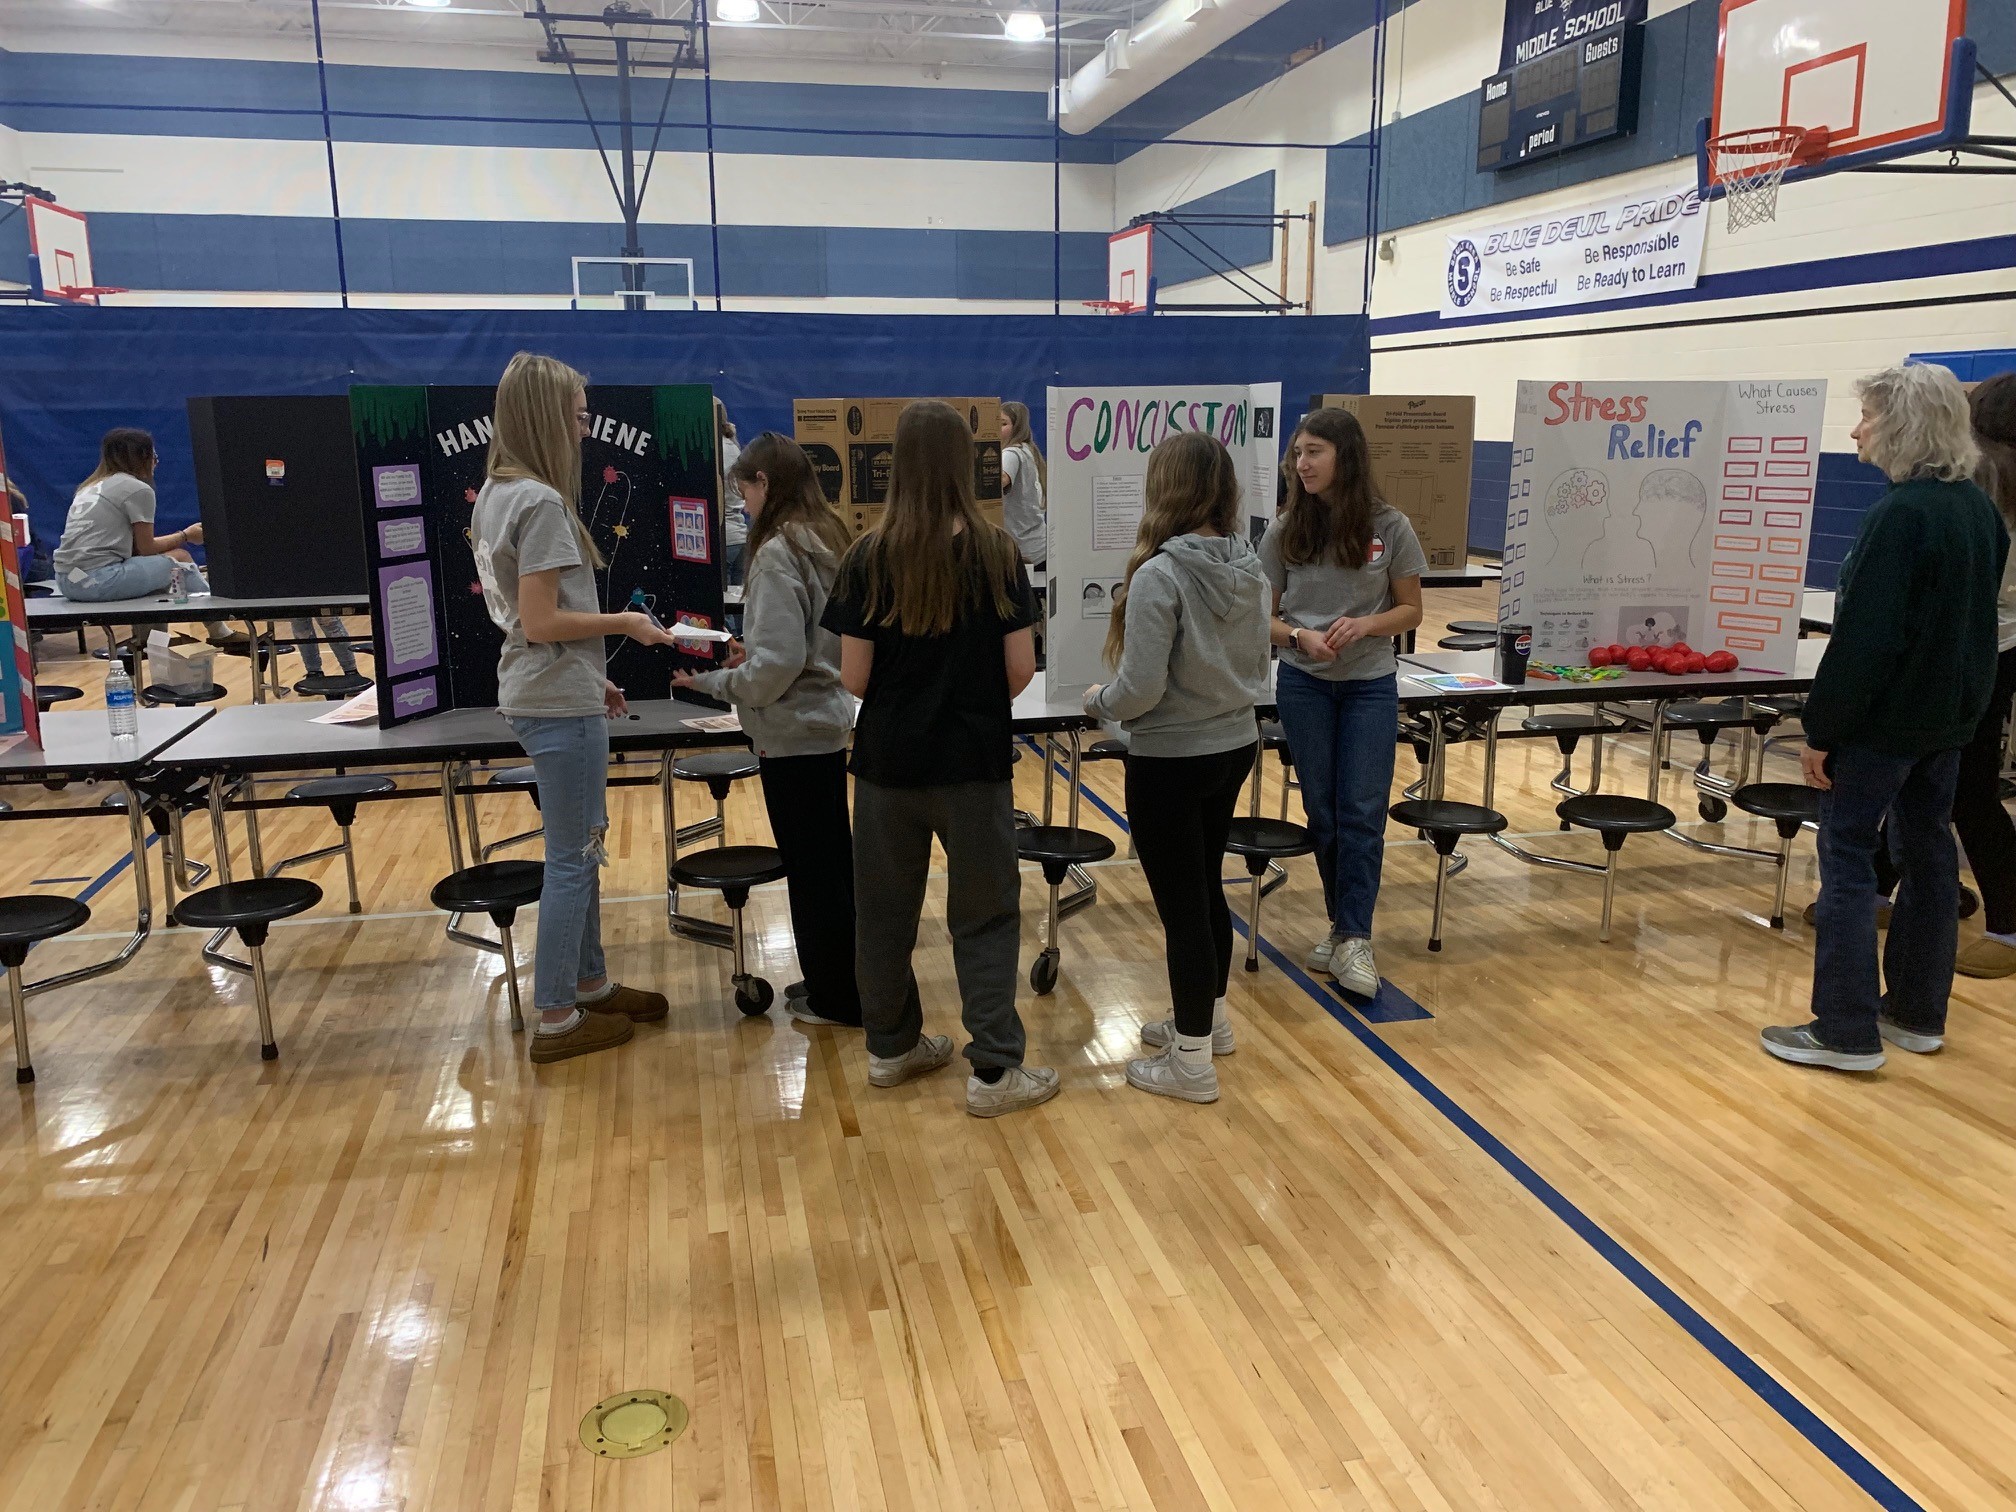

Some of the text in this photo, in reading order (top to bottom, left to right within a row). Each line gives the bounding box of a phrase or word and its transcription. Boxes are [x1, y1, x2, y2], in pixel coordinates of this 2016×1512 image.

[1535, 0, 1553, 14] BLUE
[1516, 1, 1625, 64] MIDDLE SCHOOL
[1585, 37, 1619, 63] Guests
[1486, 81, 1508, 101] Home
[1528, 124, 1556, 152] period
[1483, 189, 1701, 256] BLUE DEVIL PRIDE
[1585, 232, 1680, 264] Be Responsible
[1457, 256, 1471, 292] S
[1506, 256, 1541, 277] Be Safe
[1577, 261, 1686, 291] Be Ready to Learn
[1490, 279, 1558, 303] Be Respectful
[1544, 381, 1648, 426] Stress
[1739, 382, 1818, 399] What Causes
[1756, 401, 1796, 415] Stress
[436, 414, 652, 457] HAN IENE
[1607, 419, 1702, 460] Relief
[1583, 574, 1602, 584] What
[1606, 575, 1614, 584] is
